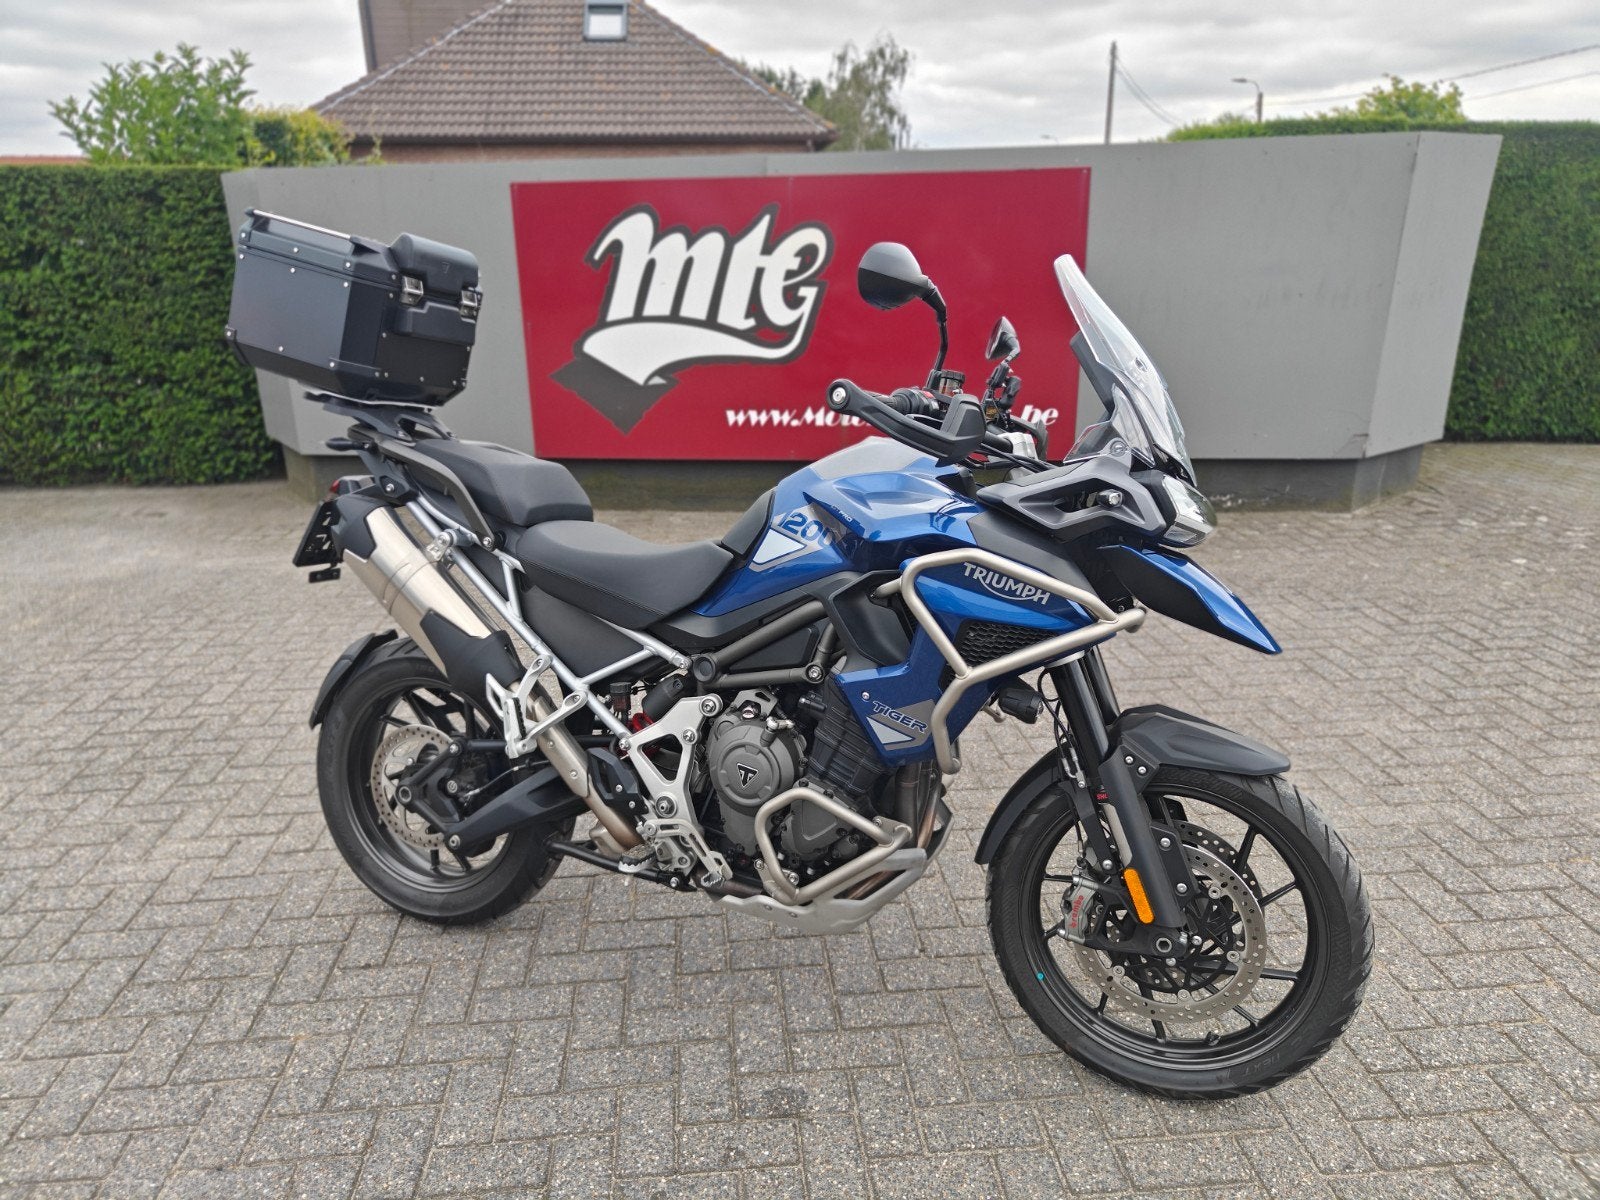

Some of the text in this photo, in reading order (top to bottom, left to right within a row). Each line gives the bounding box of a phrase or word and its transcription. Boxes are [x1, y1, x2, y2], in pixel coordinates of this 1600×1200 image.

[963, 561, 1051, 605] TRIUMPH
[872, 700, 929, 734] TIGER
[1068, 894, 1084, 929] brembo
